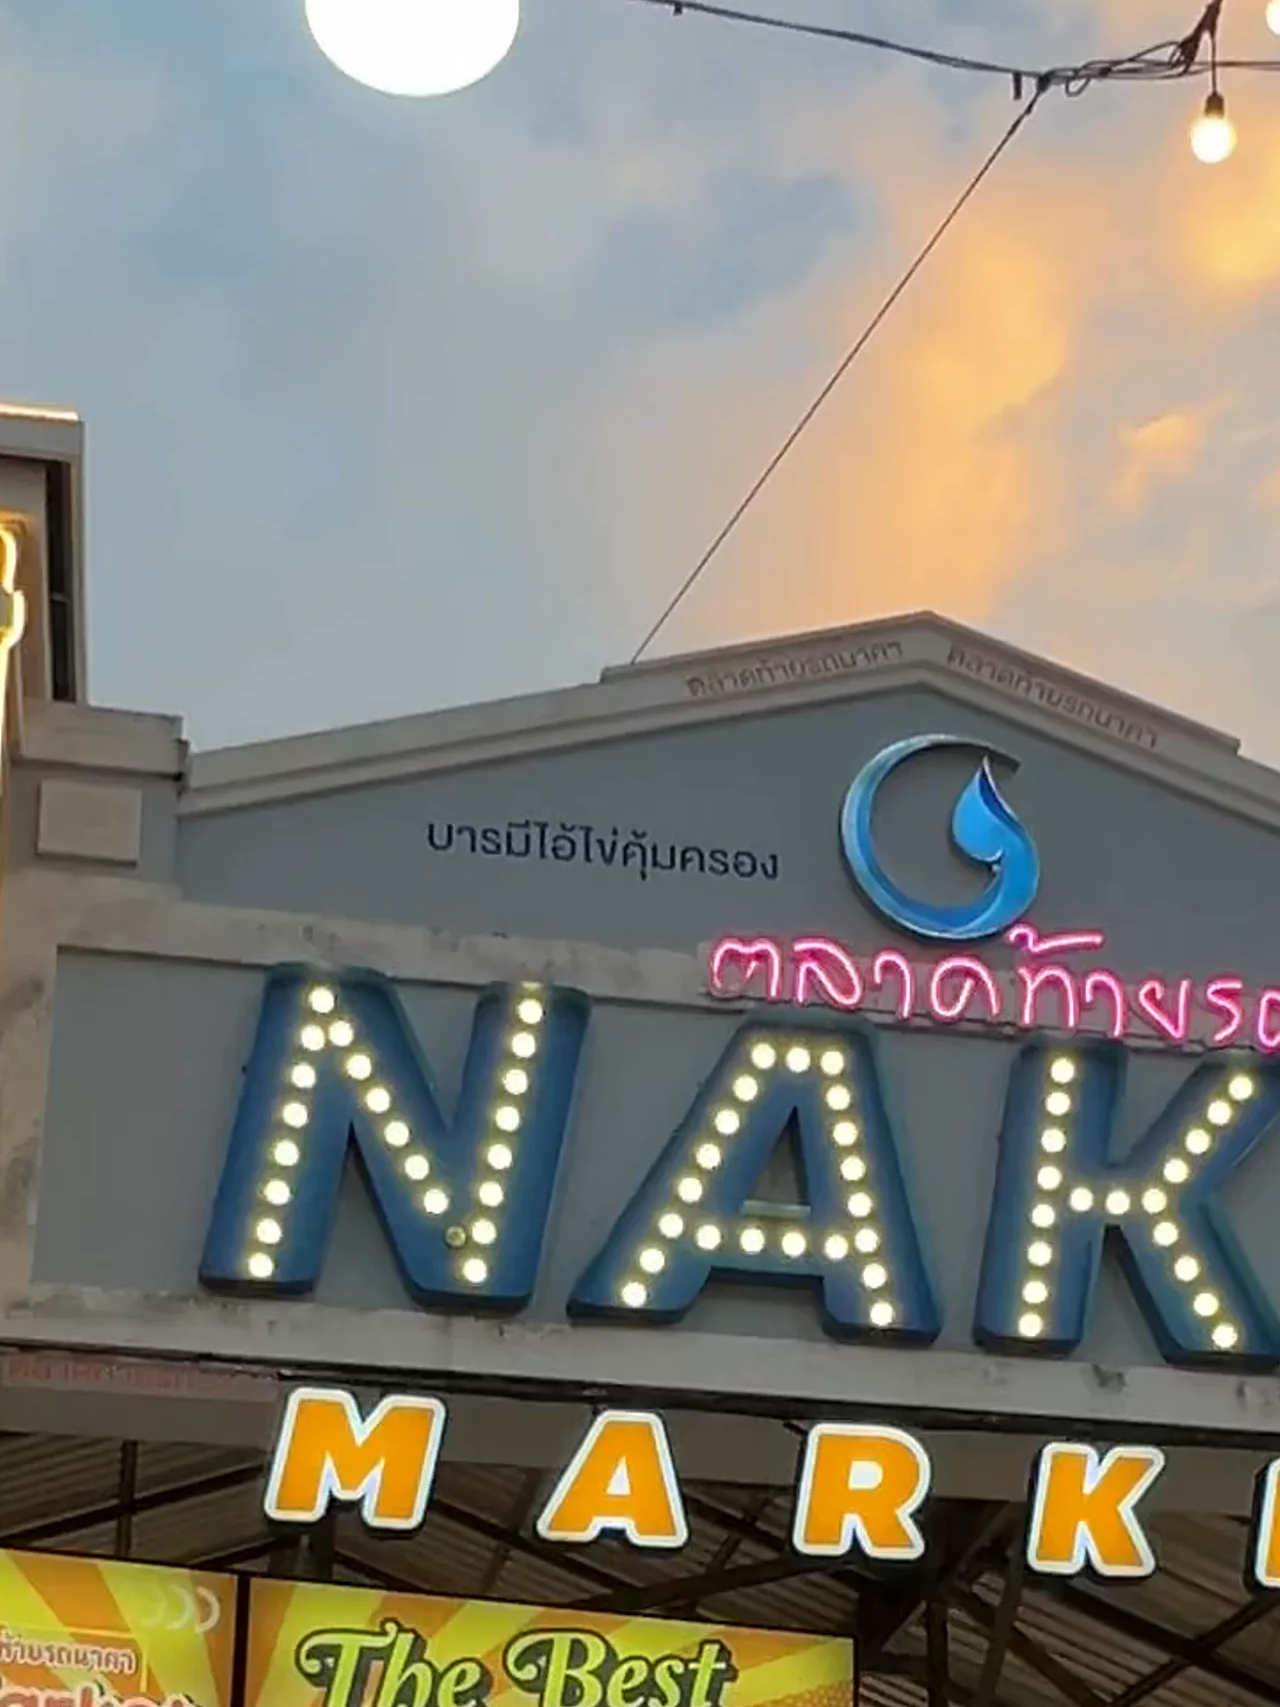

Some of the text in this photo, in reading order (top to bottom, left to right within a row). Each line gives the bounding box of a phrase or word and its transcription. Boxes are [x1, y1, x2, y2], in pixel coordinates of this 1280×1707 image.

[426, 819, 780, 881] บารมีไอ้ไข่คุ้มครอง
